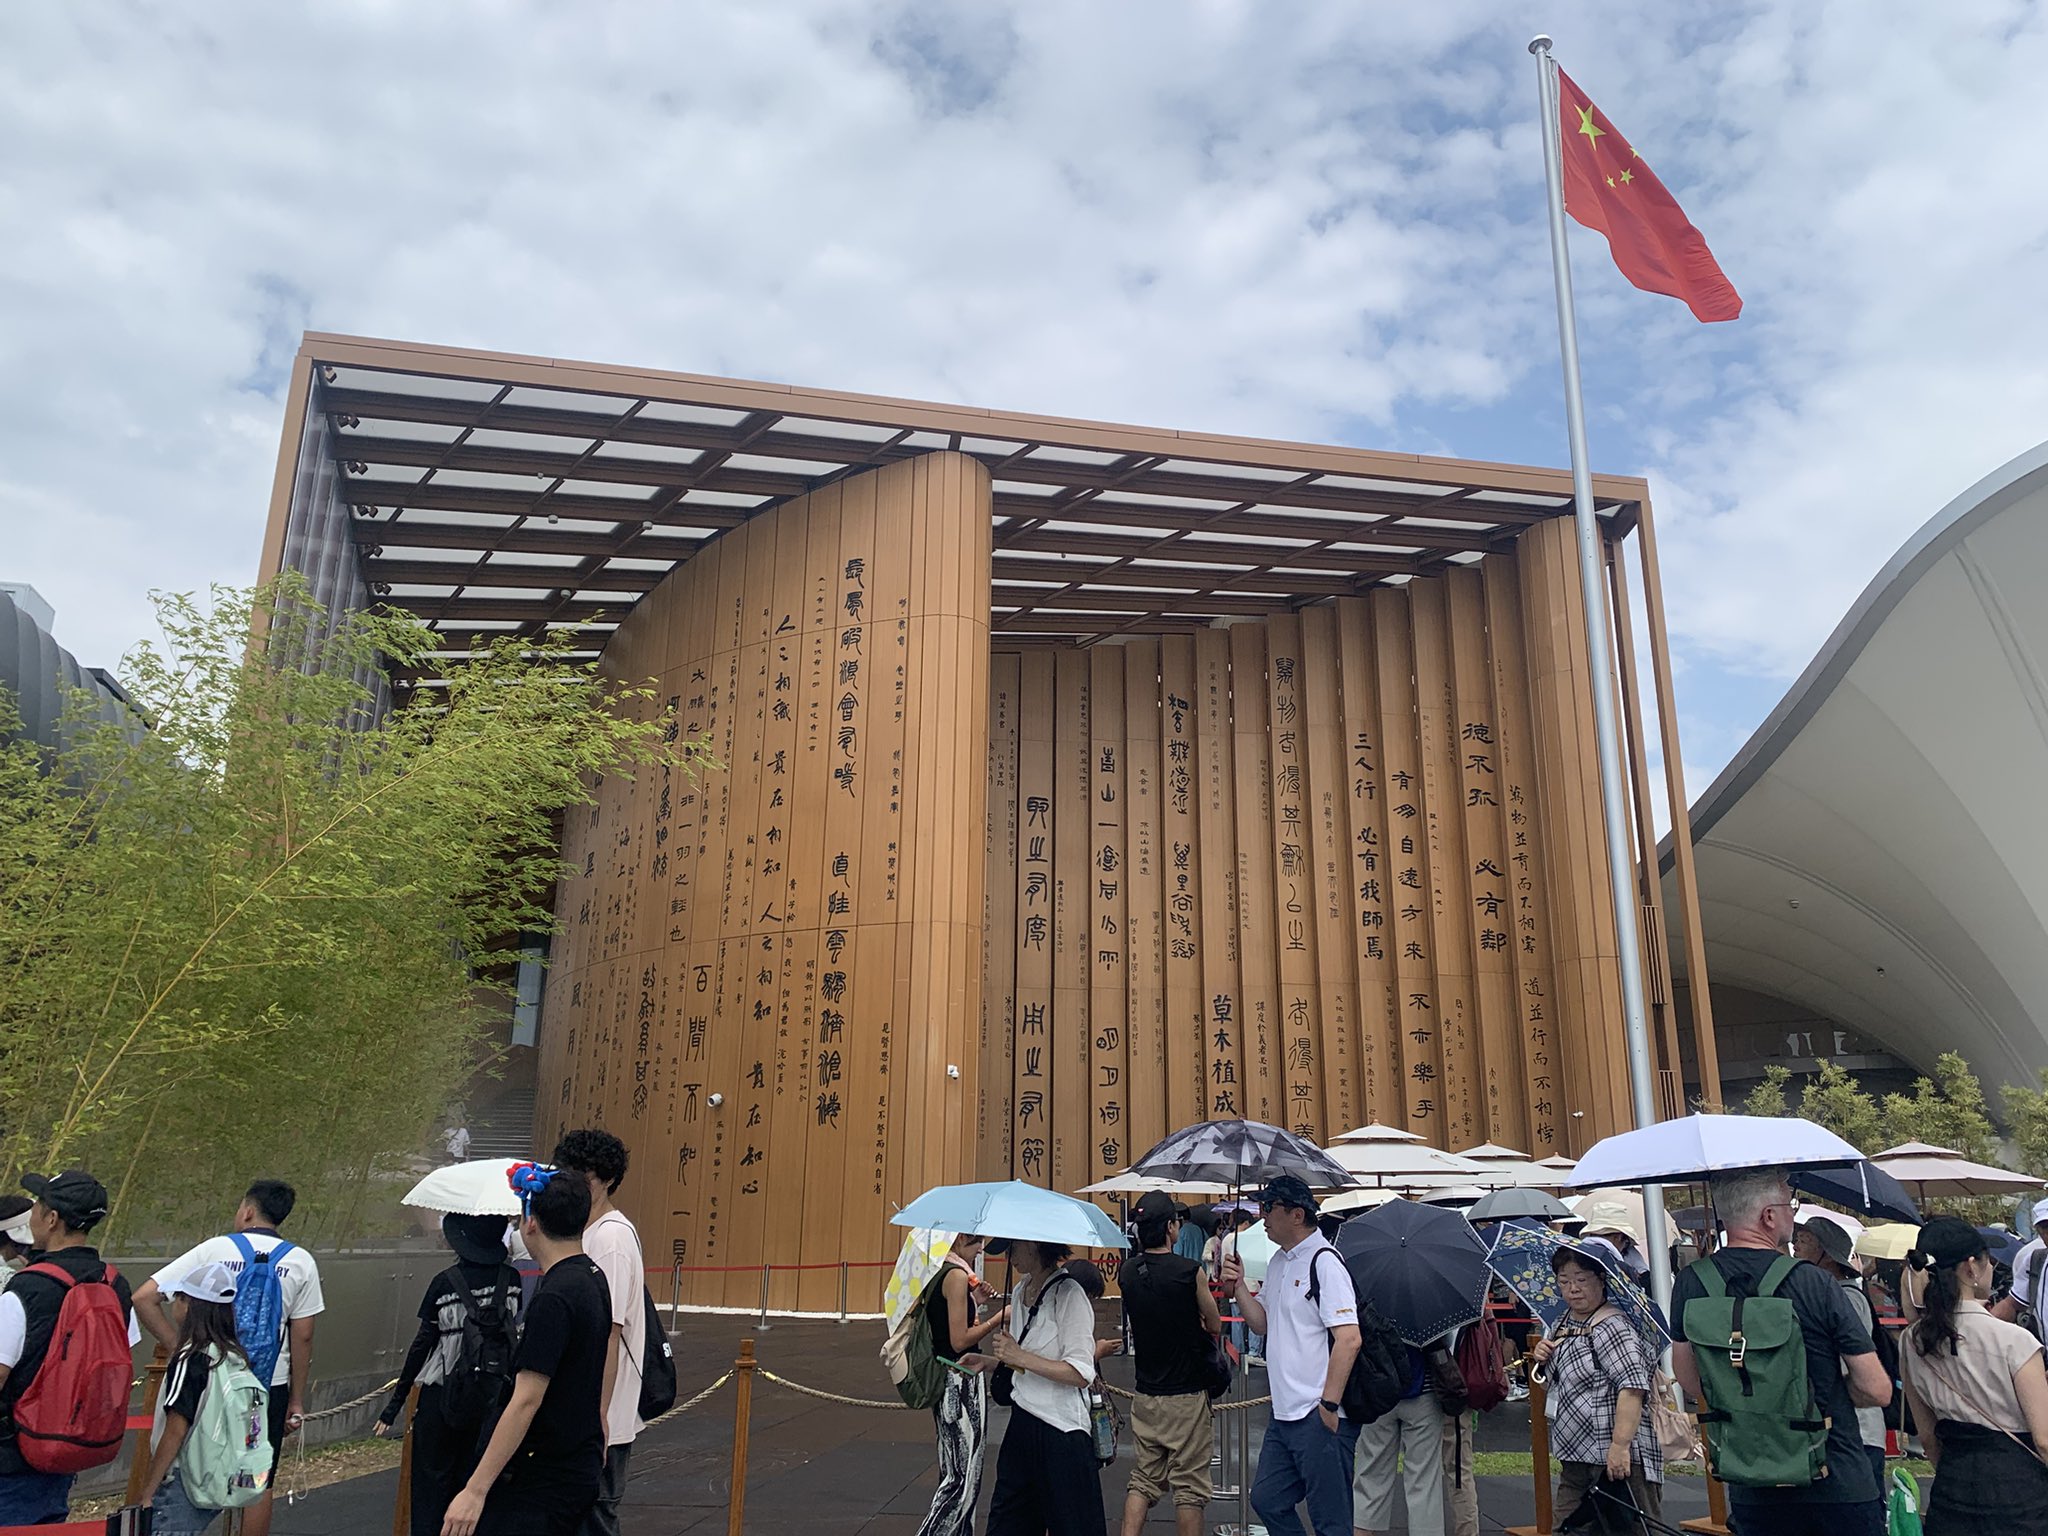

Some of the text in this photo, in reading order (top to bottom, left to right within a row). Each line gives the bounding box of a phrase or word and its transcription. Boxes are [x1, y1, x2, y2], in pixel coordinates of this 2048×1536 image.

[772, 614, 796, 722] 人之相識
[1354, 733, 1384, 960] 三人行 必有我師焉
[1475, 858, 1507, 953] 必有鄰
[1019, 796, 1049, 1177] 取之有度 用之有節
[1391, 771, 1437, 1119] 有朋自遠方來 不亦樂乎
[670, 964, 712, 1286] 百聞不如一見
[740, 1060, 765, 1194] 貴在知心
[1211, 994, 1237, 1116] 草木植成
[1524, 977, 1554, 1144] 道並行而不相悖
